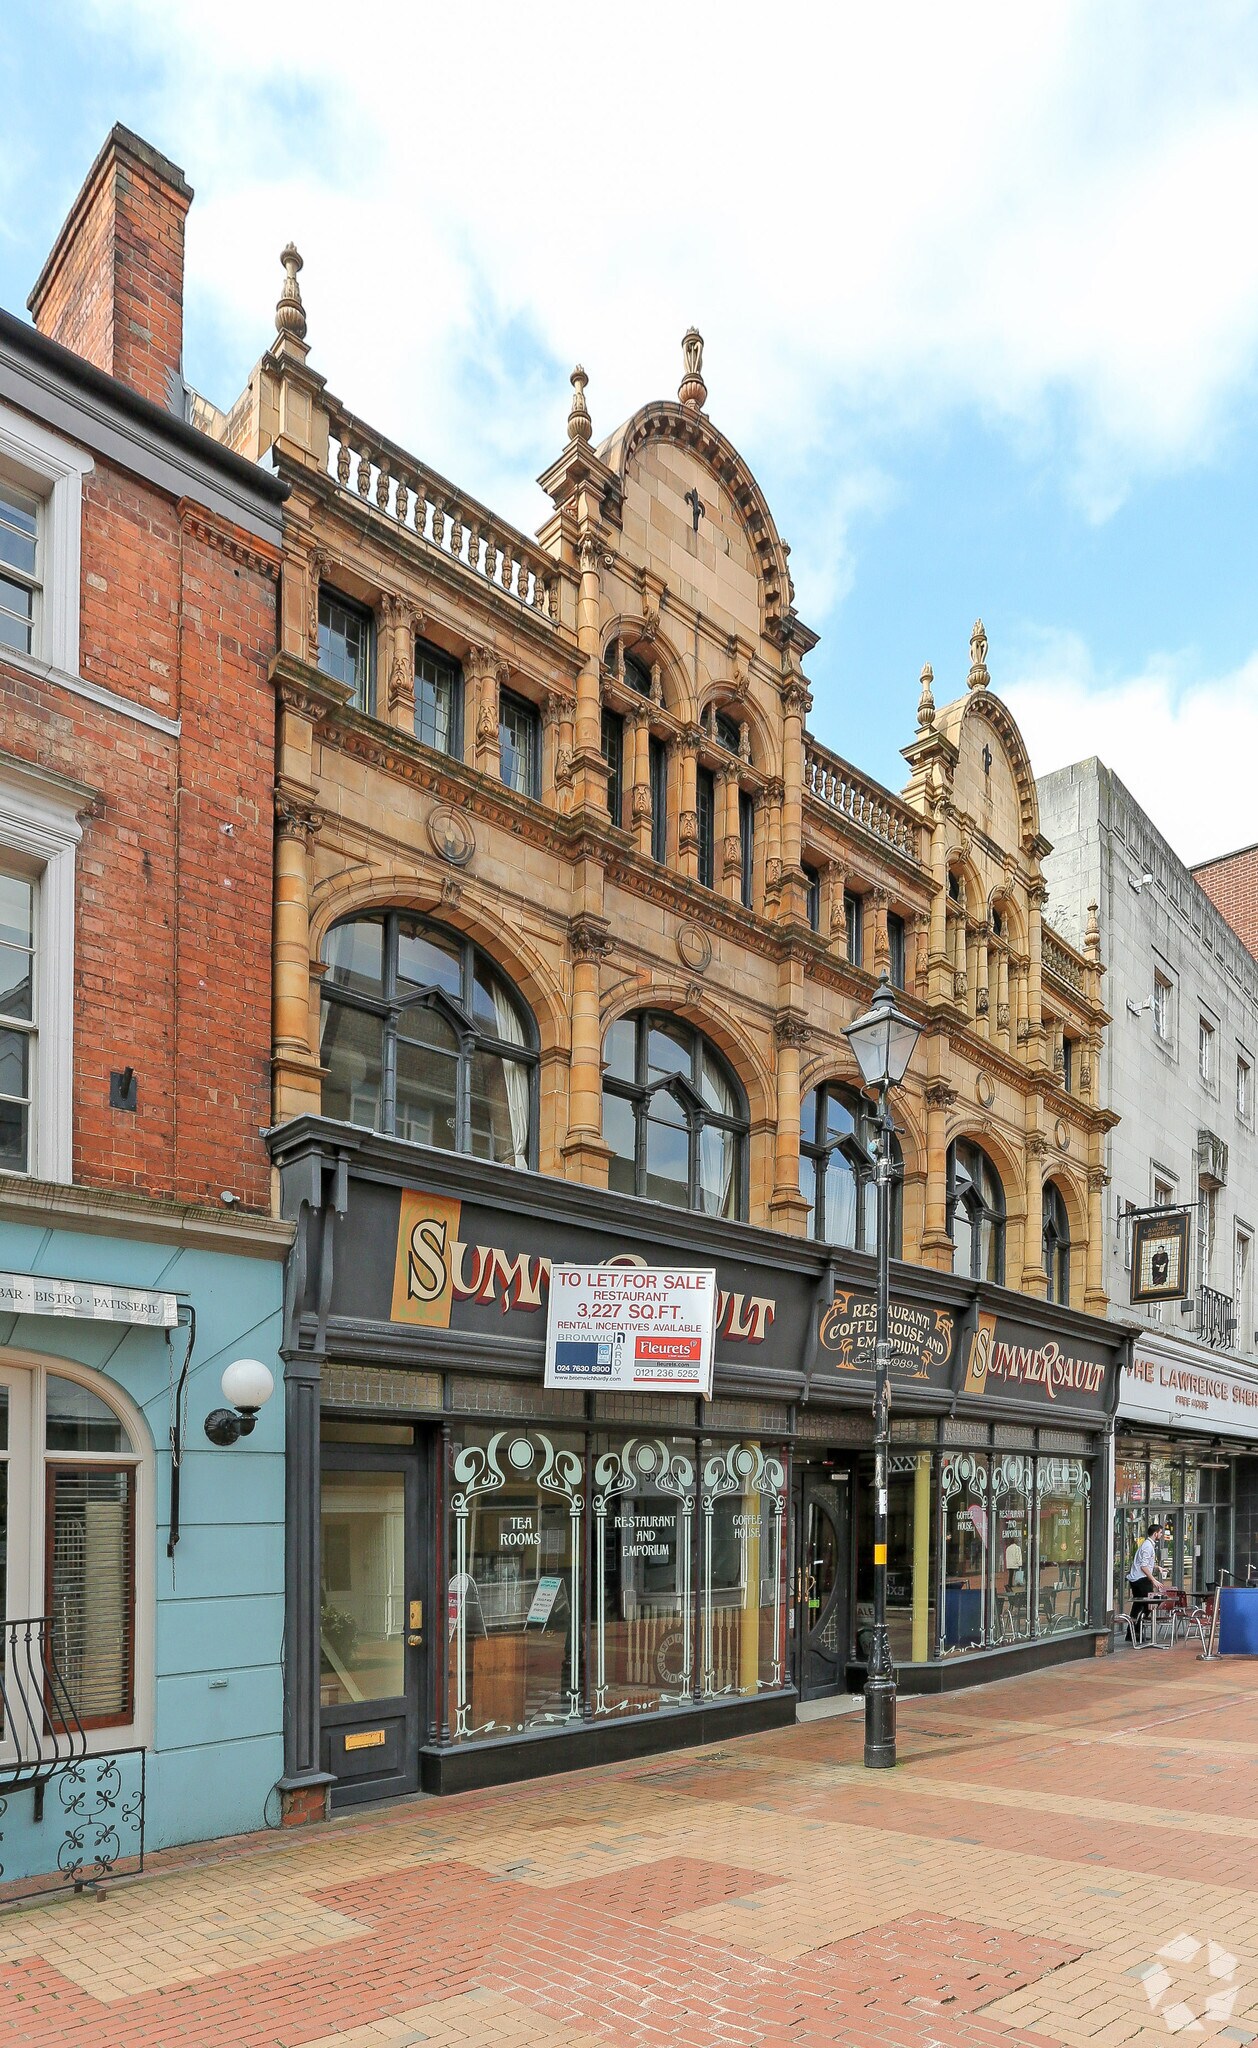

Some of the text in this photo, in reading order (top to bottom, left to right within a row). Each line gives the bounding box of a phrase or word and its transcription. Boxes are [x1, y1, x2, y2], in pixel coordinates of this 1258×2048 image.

[559, 1272, 707, 1290] TO LET/FOR SALE
[593, 1290, 669, 1302] RESTAURANT
[35, 1291, 83, 1306] BISTRO
[94, 1297, 160, 1315] PATISSERIE
[577, 1303, 684, 1321] 3,227 SQ.FT.
[557, 1320, 702, 1333] RENTAL INCENTIVES AVAILABLE
[640, 1341, 691, 1355] Fleurets
[925, 1336, 944, 1356] AND
[557, 1364, 571, 1372] 024
[972, 1327, 1106, 1399] SUMMERSAULT
[635, 1368, 699, 1378] 0121 236 5252
[1127, 1359, 1155, 1383] HE
[1160, 1366, 1229, 1400] LAWRENCE
[510, 1516, 533, 1530] TEA
[614, 1515, 677, 1528] RESTAURANT
[732, 1514, 763, 1526] COFFEE
[500, 1532, 542, 1546] ROOMS
[636, 1530, 656, 1542] AND
[734, 1528, 761, 1539] HOUSE
[622, 1544, 669, 1557] EMPORIUM
